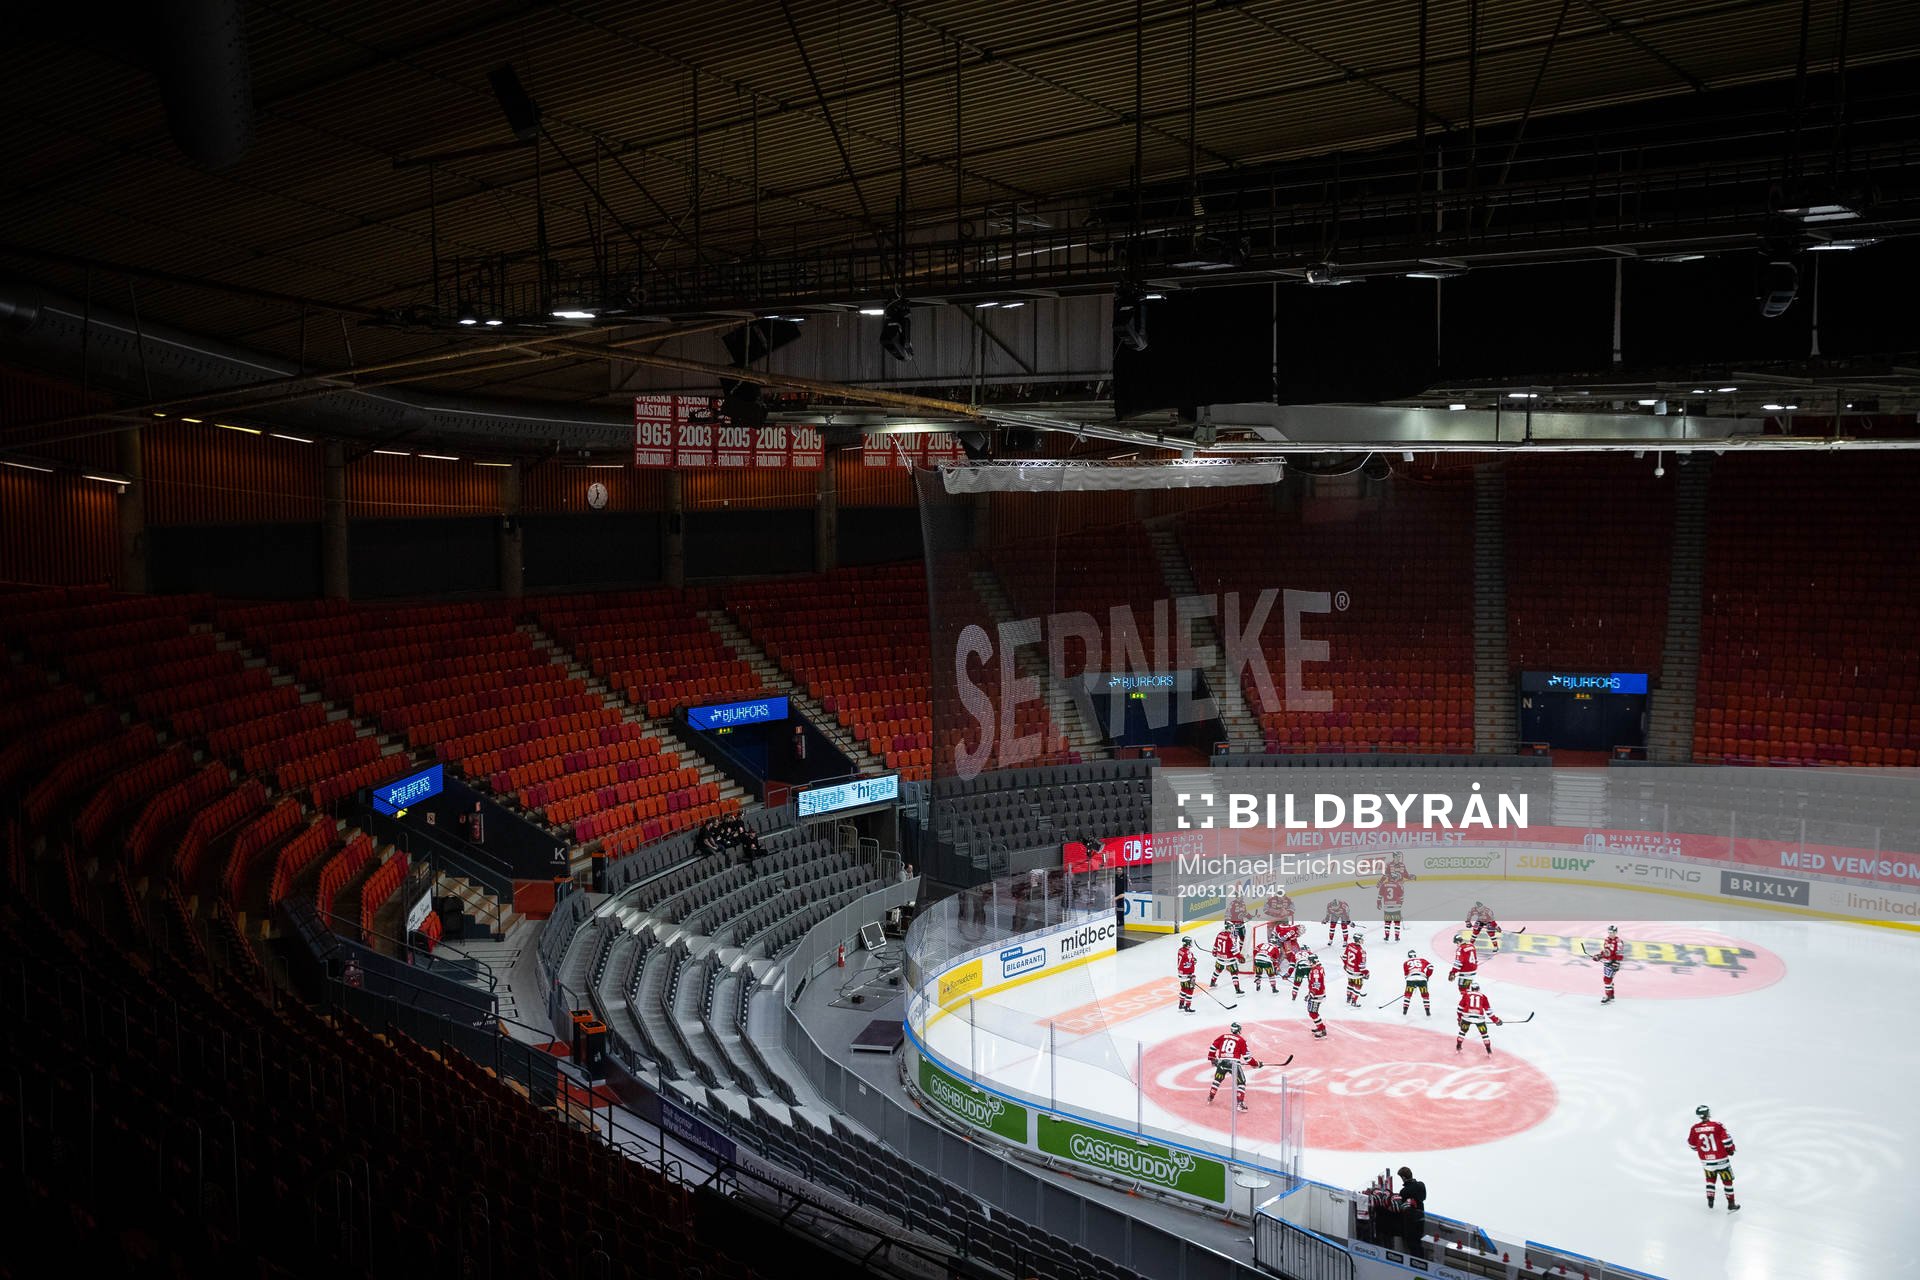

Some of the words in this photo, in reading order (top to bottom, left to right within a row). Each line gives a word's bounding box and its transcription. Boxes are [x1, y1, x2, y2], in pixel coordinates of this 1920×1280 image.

[636, 403, 671, 417] MÄSTARE
[636, 422, 672, 446] 1965
[678, 425, 712, 446] 2003
[718, 426, 750, 448] 2005
[756, 427, 787, 449] 2016
[792, 428, 822, 450] 2019
[636, 451, 665, 465] FRÖLUNDA
[678, 453, 706, 467] FRÖLUNDA
[1122, 675, 1174, 690] BJURFORS
[1562, 676, 1621, 690] BJURFORS
[722, 704, 769, 723] BJURFORS
[857, 778, 895, 801] higab
[1286, 832, 1323, 847] MED
[1609, 834, 1681, 846] NINTENDO
[554, 847, 566, 861] K
[1780, 851, 1825, 870] MED
[1425, 857, 1491, 869] CASHBUDDY
[1517, 855, 1595, 871] SUBWAY
[1634, 863, 1702, 883] STING
[1386, 888, 1394, 899] 3
[1730, 878, 1799, 898] BRIXLY
[1061, 923, 1116, 953] midbec
[1217, 939, 1227, 953] 51
[1005, 953, 1044, 972] BILGARANTI
[1469, 951, 1476, 964] 4
[1470, 995, 1481, 1008] 11
[1221, 1039, 1236, 1054] 18
[931, 1080, 993, 1126] CASHBUDDY
[1699, 1133, 1718, 1152] 31
[1073, 1139, 1178, 1183] CASHBUDDY
